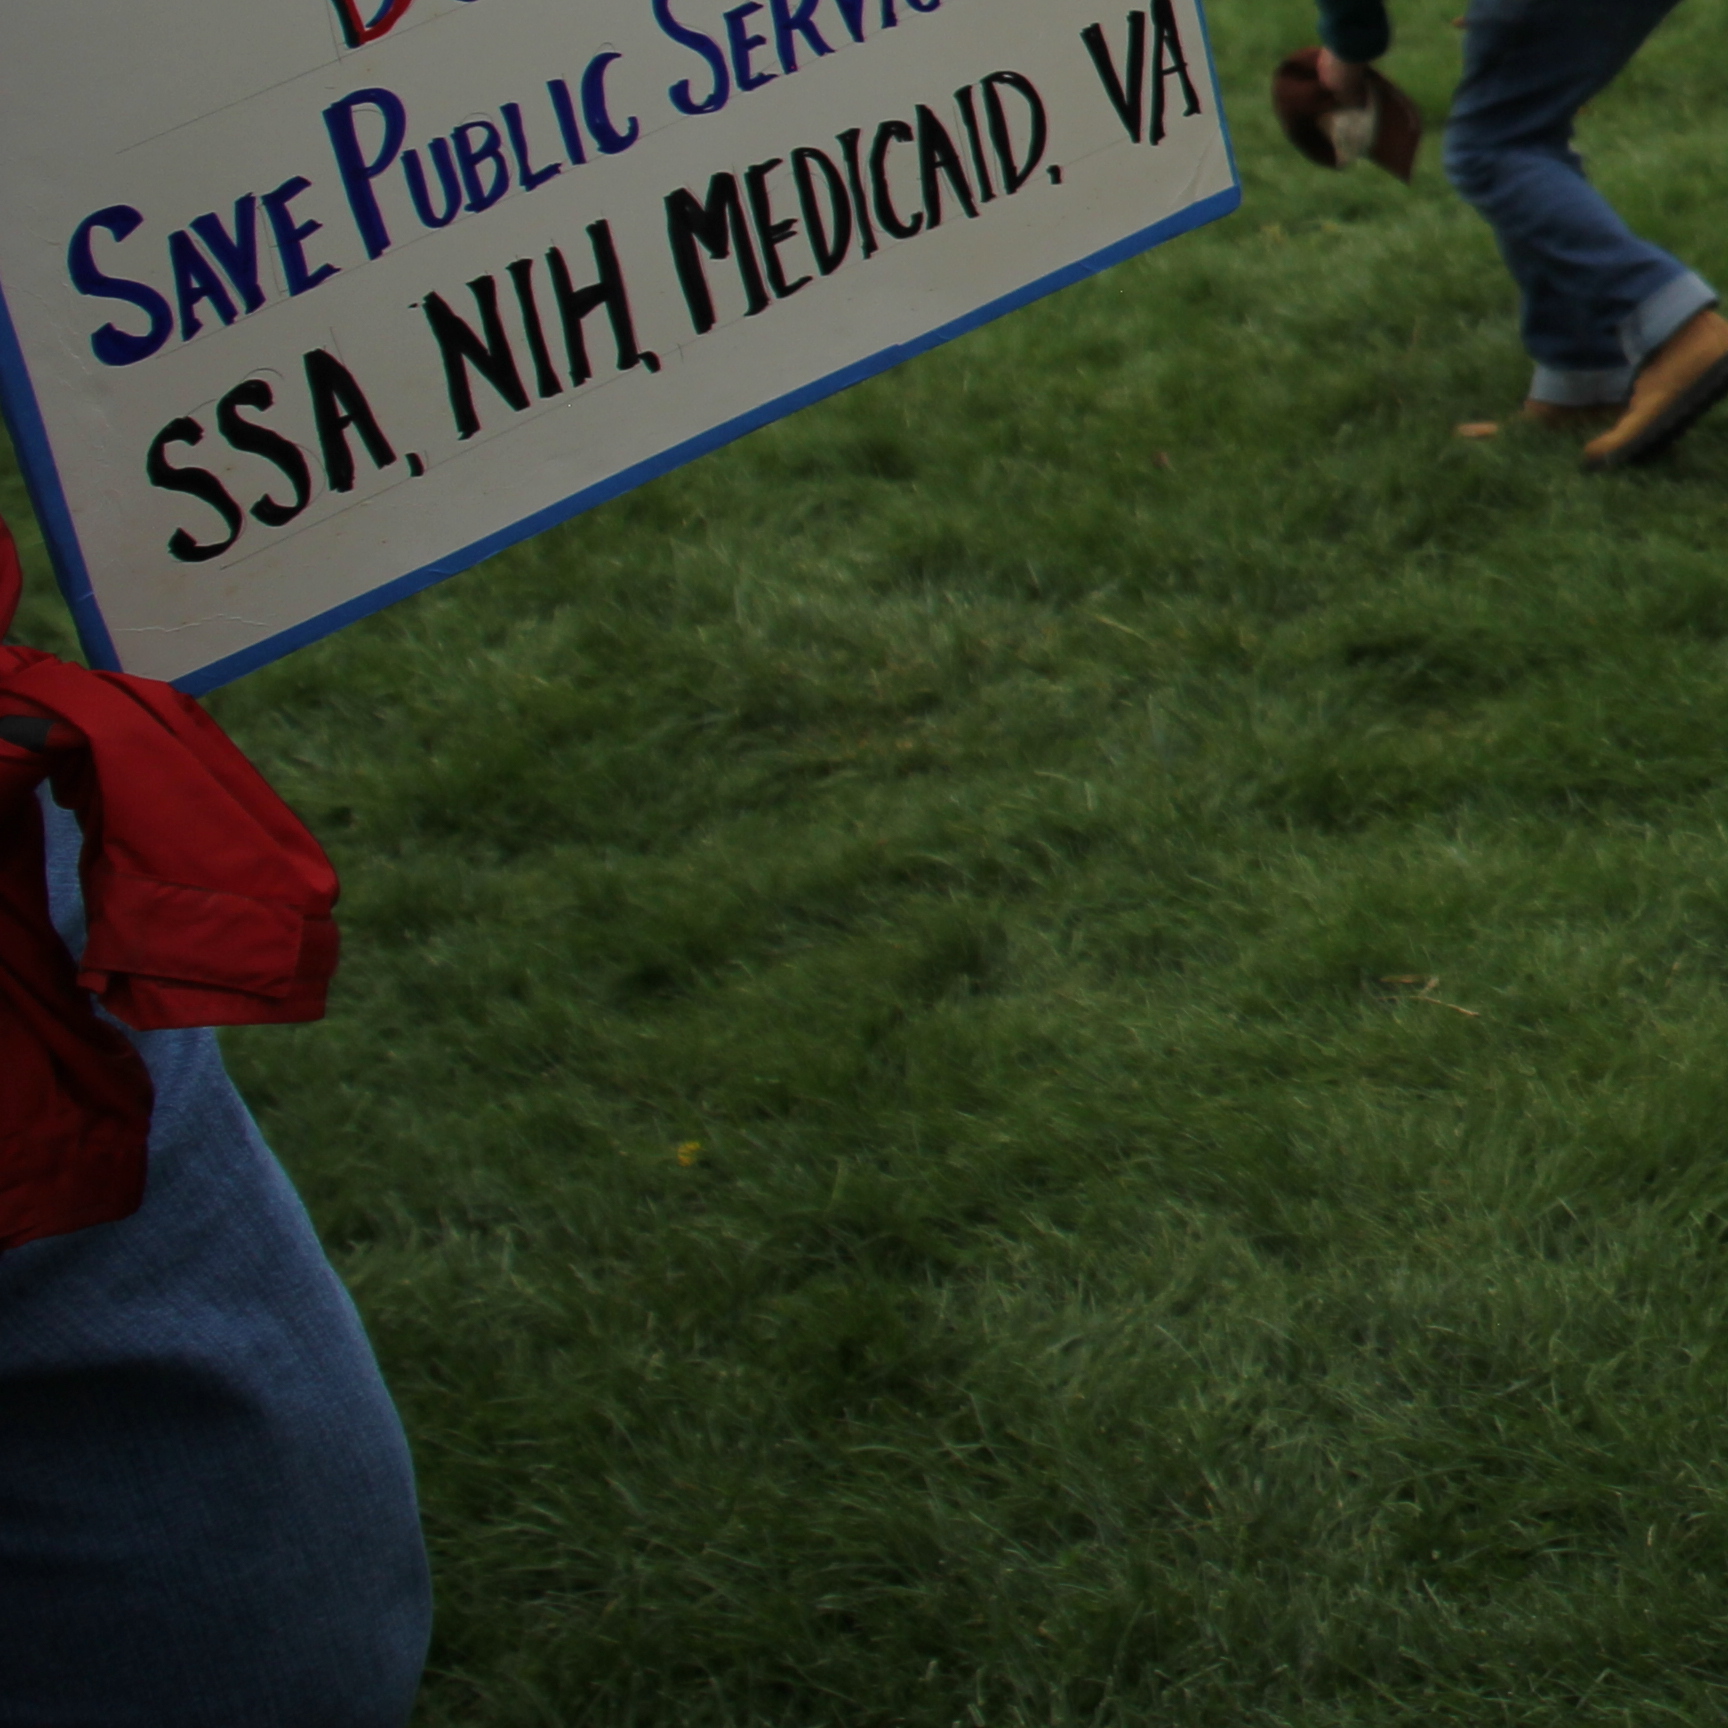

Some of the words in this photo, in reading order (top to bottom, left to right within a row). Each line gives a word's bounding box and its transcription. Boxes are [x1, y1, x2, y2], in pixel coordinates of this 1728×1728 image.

[67, 176, 341, 368] SAVE
[322, 51, 640, 261] PUBLIC
[147, 348, 425, 563] SSA,
[408, 219, 661, 440] NIH,
